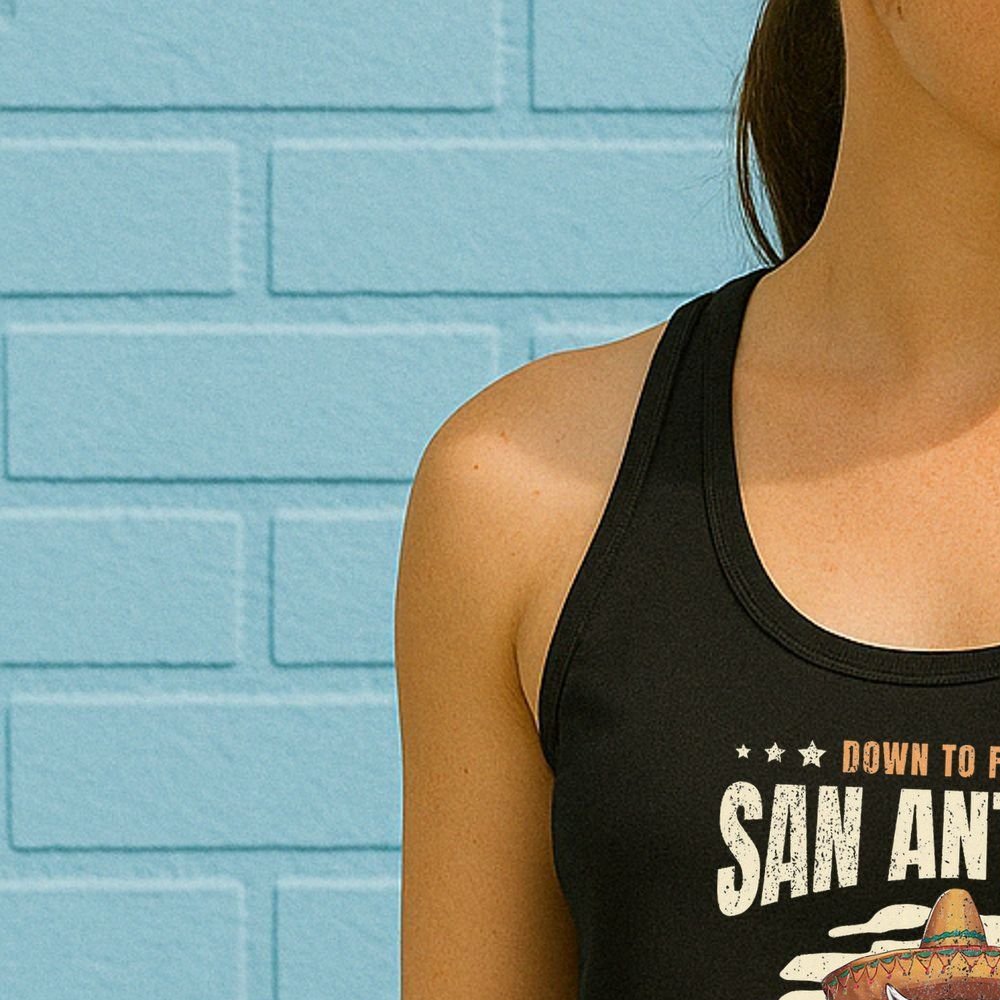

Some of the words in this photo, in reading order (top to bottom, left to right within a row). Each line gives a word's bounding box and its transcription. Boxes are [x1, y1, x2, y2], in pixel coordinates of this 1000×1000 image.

[842, 739, 929, 777] DOWN
[941, 743, 976, 779] TO
[716, 780, 864, 917] SAN
